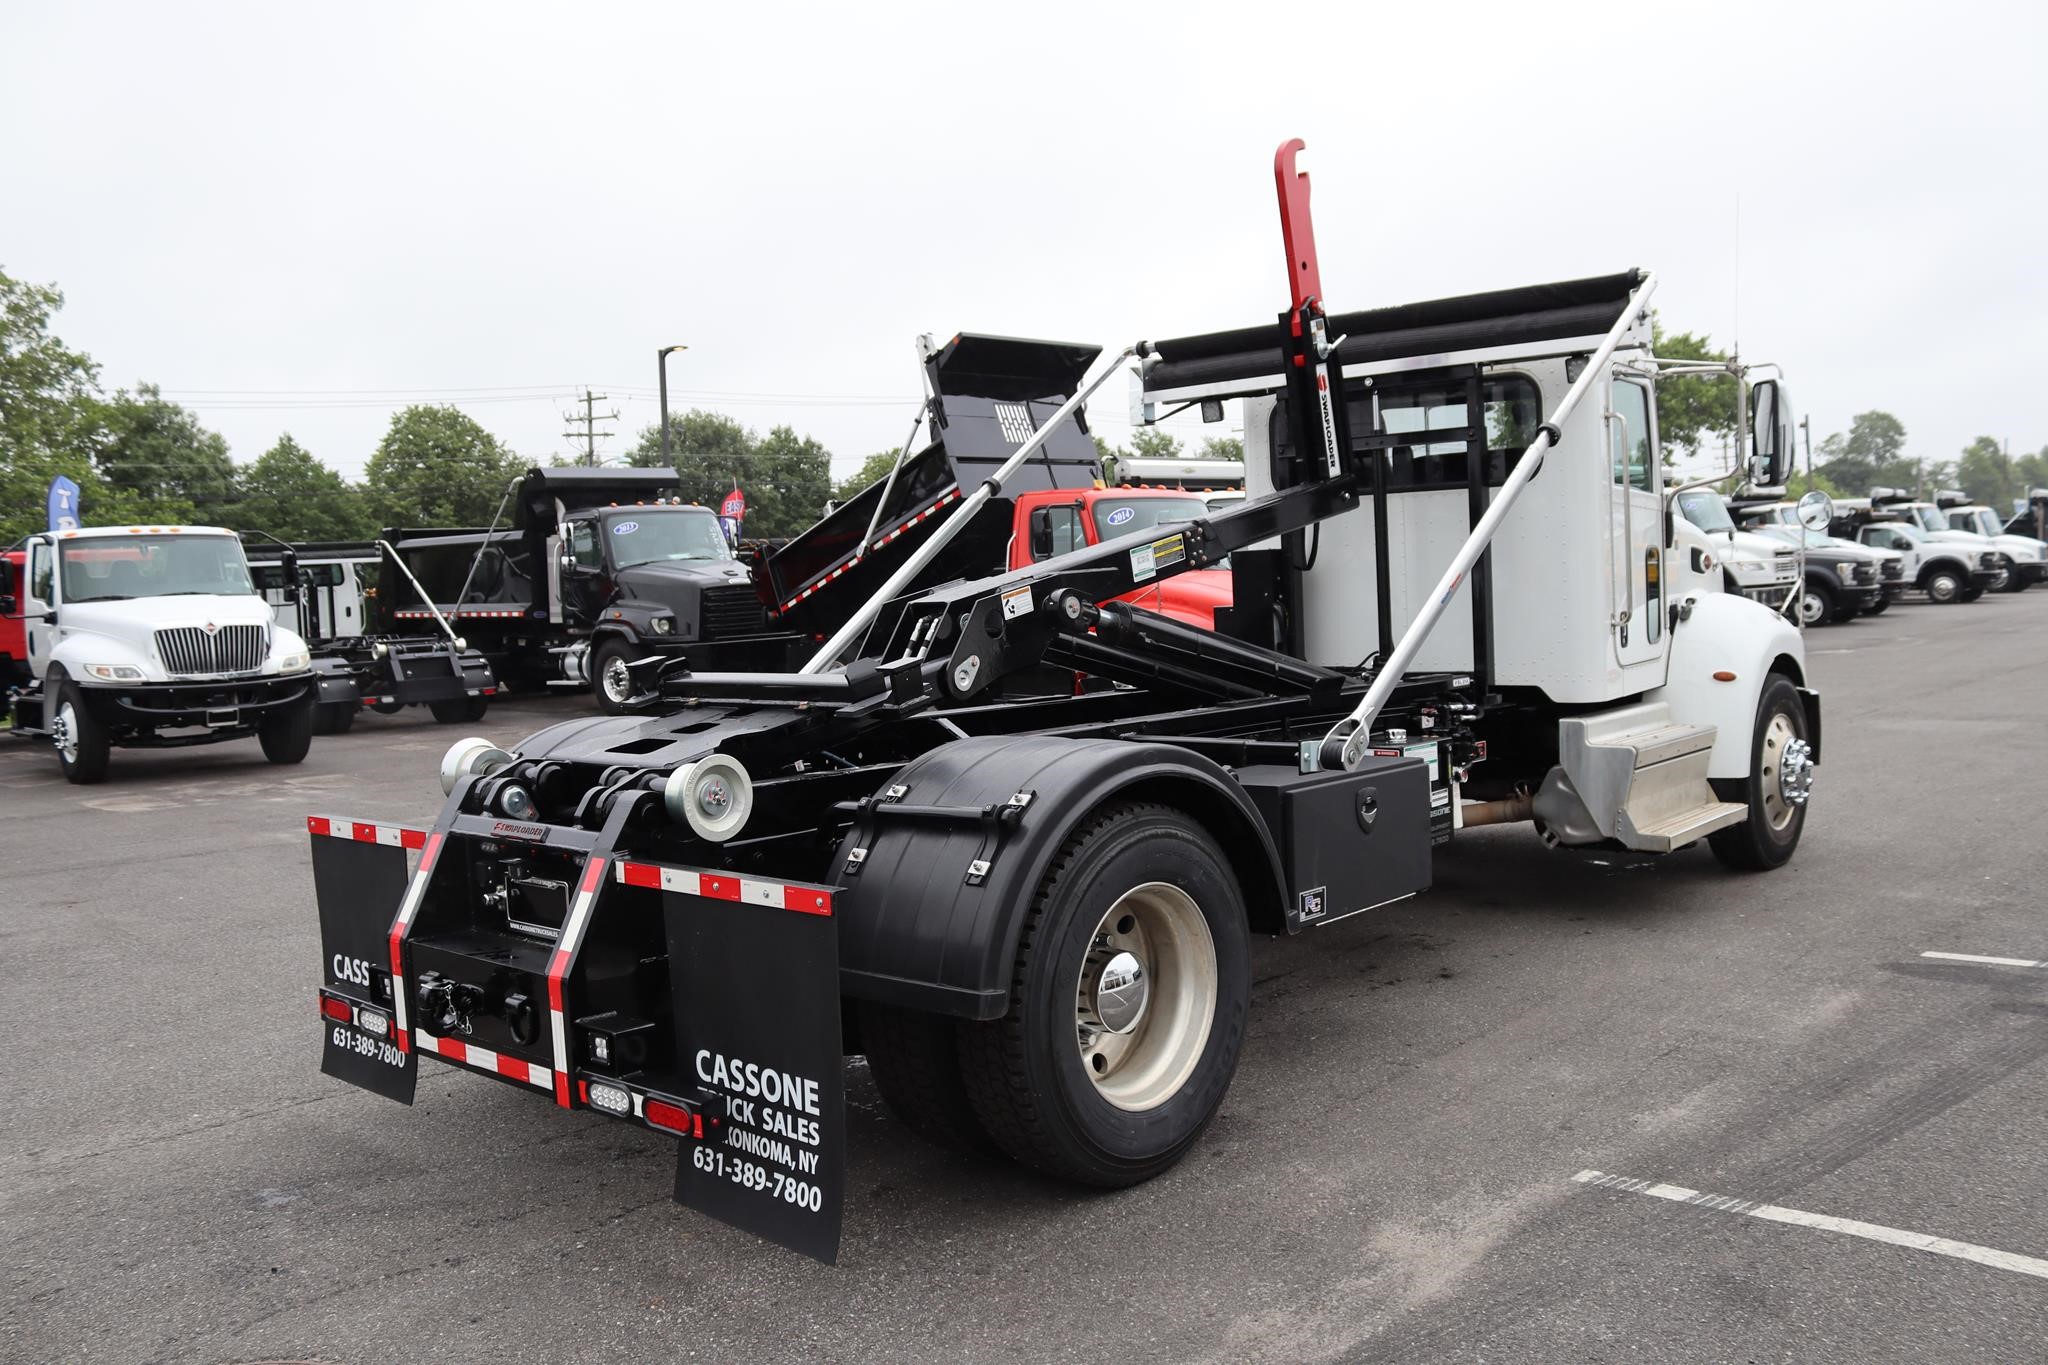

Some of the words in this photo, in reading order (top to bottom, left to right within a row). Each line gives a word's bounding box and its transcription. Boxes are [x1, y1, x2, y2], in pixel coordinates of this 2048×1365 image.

[1321, 394, 1335, 468] SWAPLOADER
[1112, 508, 1131, 523] 2014
[333, 954, 370, 987] CASS
[333, 1027, 405, 1068] 631-389-7800
[695, 1049, 821, 1117] CASSONE
[762, 1107, 820, 1146] SALES
[726, 1126, 796, 1170] KONKOMA,
[798, 1149, 819, 1175] NY
[693, 1146, 822, 1213] 631-389-7800
